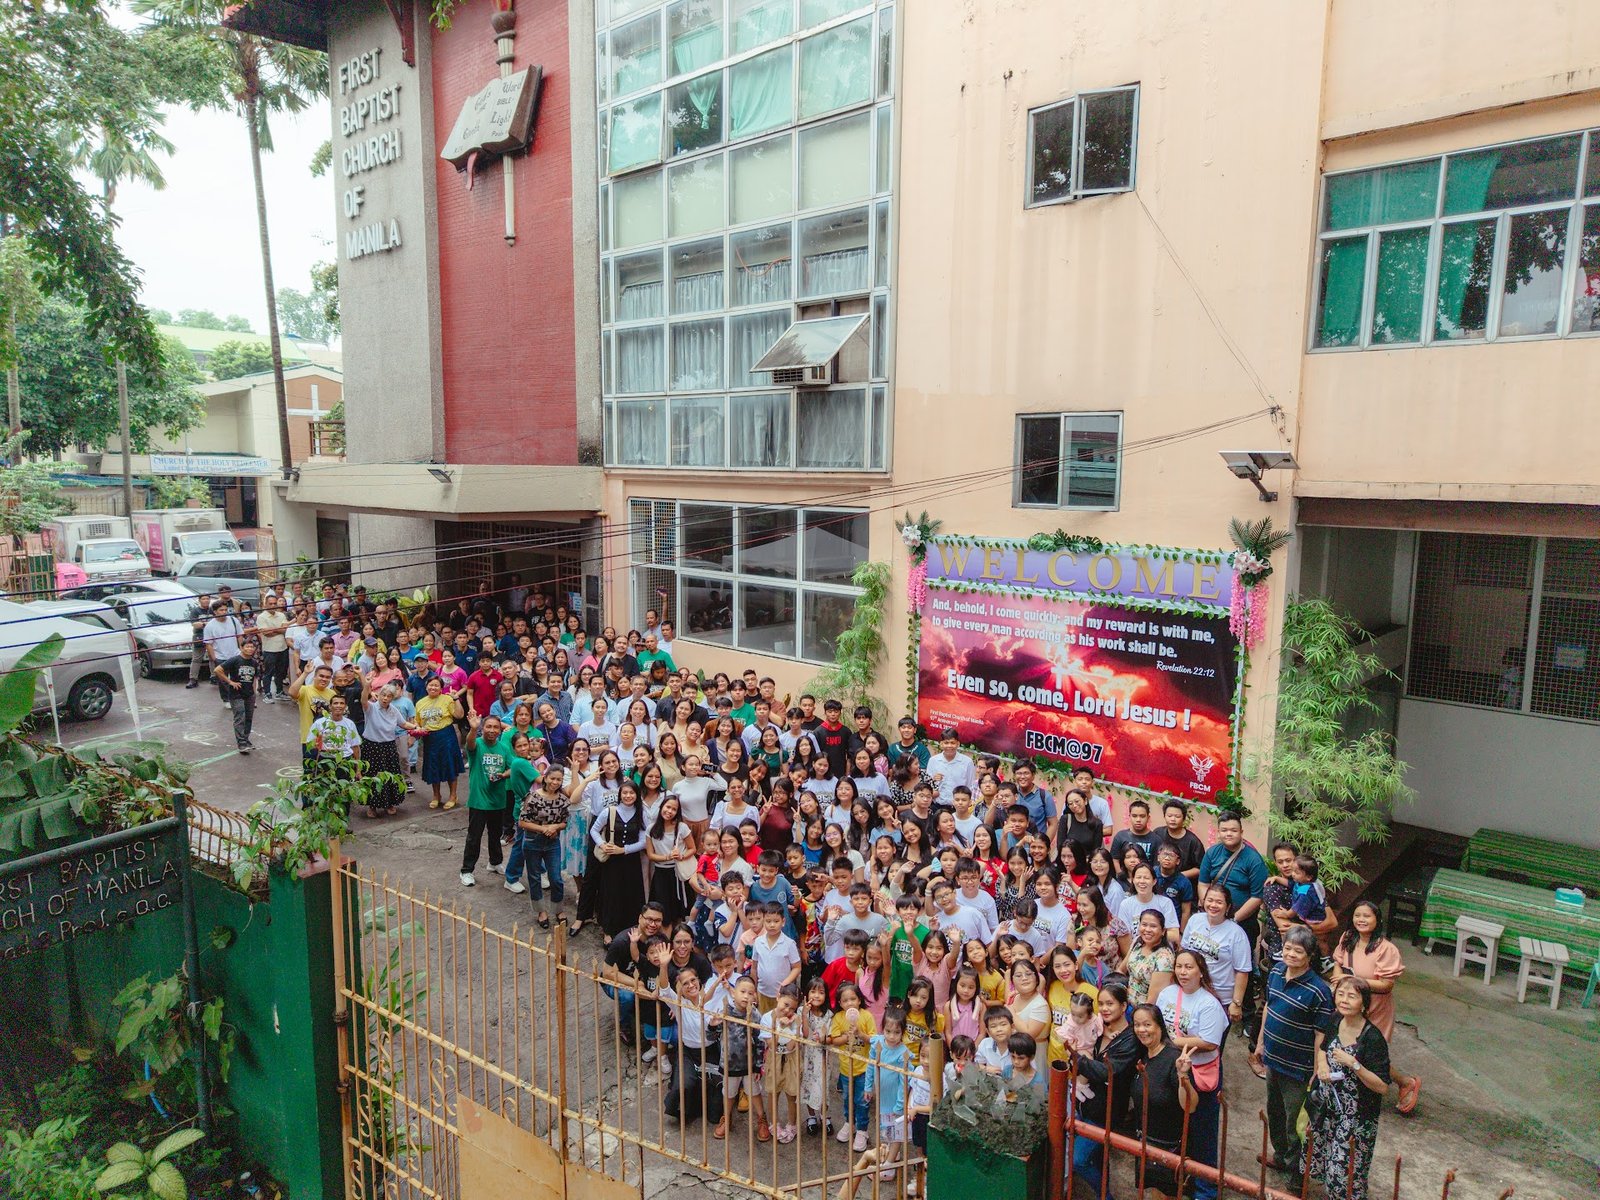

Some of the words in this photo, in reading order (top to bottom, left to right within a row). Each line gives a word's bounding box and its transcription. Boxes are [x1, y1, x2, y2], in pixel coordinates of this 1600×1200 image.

[338, 47, 383, 96] FIRST
[340, 82, 402, 138] BAPTIST
[341, 128, 402, 178] CHURCH
[343, 185, 365, 219] OF
[345, 217, 403, 261] MANILA
[937, 543, 1221, 600] WELCOME
[932, 598, 952, 612] And,
[954, 600, 988, 616] behold,
[989, 604, 994, 616] I
[996, 606, 1021, 619] come
[1064, 614, 1084, 626] and
[1086, 617, 1103, 630] my
[1105, 619, 1146, 635] reward
[1148, 622, 1160, 636] is
[1162, 625, 1189, 640] with
[1191, 629, 1215, 644] me,
[932, 615, 941, 626] to
[943, 616, 962, 629] give
[964, 620, 989, 633] every
[991, 623, 1012, 635] man
[1014, 627, 1060, 644] according
[1063, 633, 1076, 644] as
[1078, 633, 1095, 647] his
[1097, 638, 1126, 651] work
[1128, 640, 1156, 656] shall
[1158, 643, 1178, 658] be.
[1156, 660, 1193, 675] Revelation
[1192, 666, 1215, 678] 22:12
[947, 668, 985, 694] Even
[988, 680, 1013, 702] so,
[1017, 685, 1069, 712] come,
[1073, 690, 1116, 718] Lord
[1121, 696, 1177, 728] Jesus
[1183, 708, 1191, 732] !
[1026, 730, 1104, 764] FBCM@97
[1189, 781, 1211, 792] FBCM
[60, 836, 161, 884] BAPTIST
[2, 902, 35, 931] CH
[48, 886, 79, 915] OF
[87, 860, 179, 905] MANILA
[135, 893, 172, 916] Q.C.
[895, 942, 913, 953] FBC
